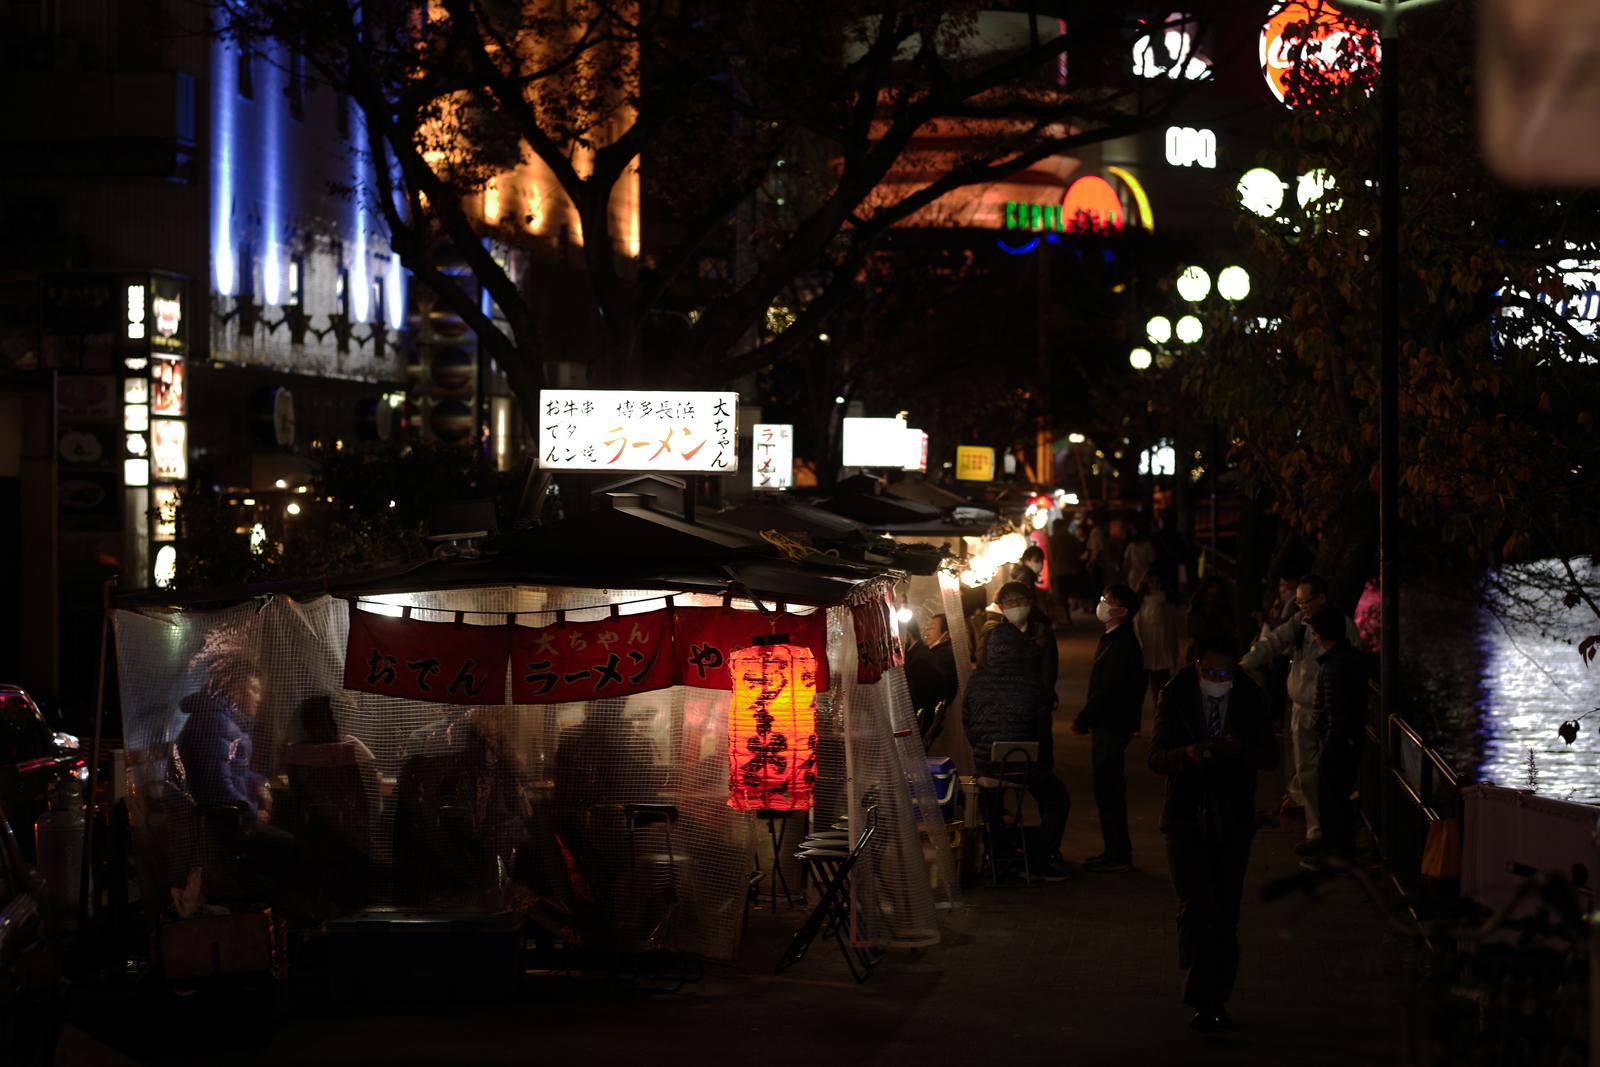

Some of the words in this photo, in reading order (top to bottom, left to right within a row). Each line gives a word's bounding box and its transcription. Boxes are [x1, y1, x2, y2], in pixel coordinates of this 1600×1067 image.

[563, 399, 578, 462] 牛タン
[615, 399, 695, 419] 博多長浜
[710, 397, 731, 468] 大ちゃん
[603, 425, 707, 464] ラーメン
[534, 621, 649, 657] 大ちゃん
[367, 648, 489, 698] おでん
[526, 644, 661, 697] ラーメン
